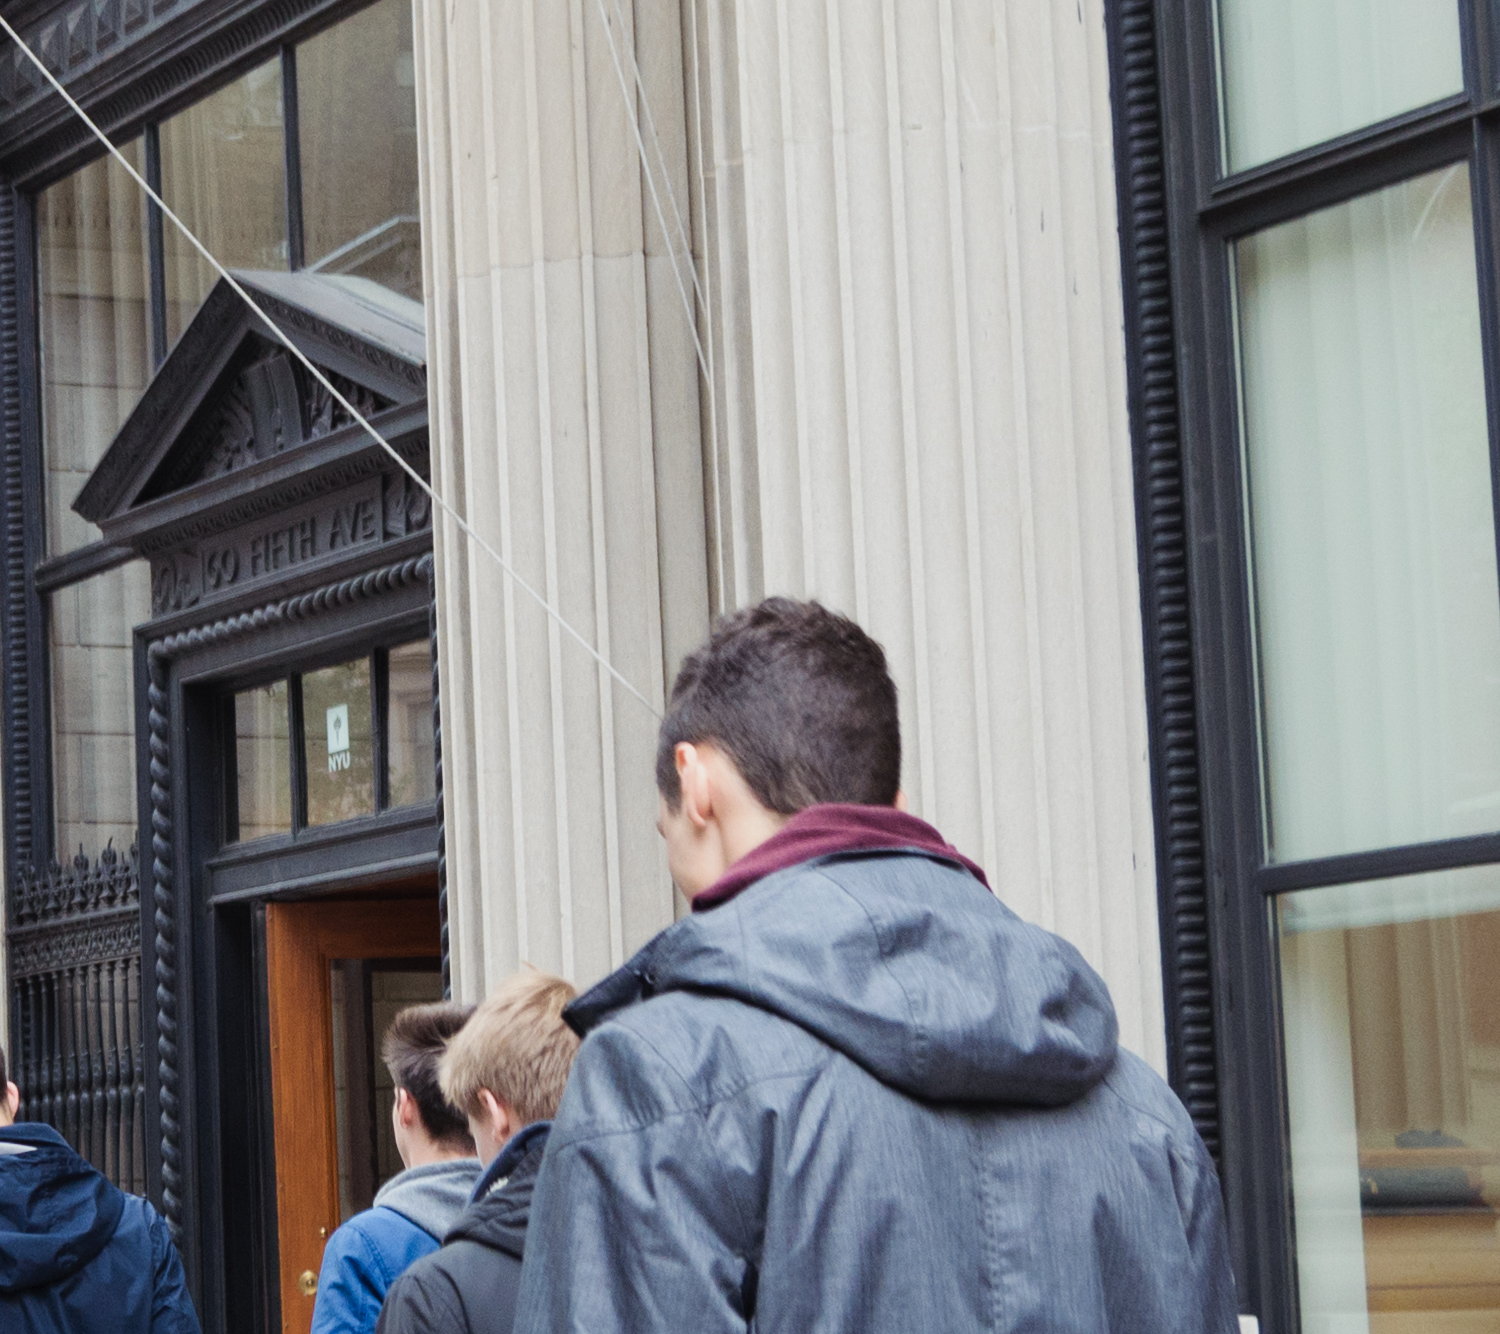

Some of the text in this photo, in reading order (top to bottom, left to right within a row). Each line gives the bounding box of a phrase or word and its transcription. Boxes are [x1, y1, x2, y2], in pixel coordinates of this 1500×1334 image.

[251, 515, 317, 578] FIFTH
[329, 497, 377, 551] AVE
[328, 750, 351, 773] NYU
